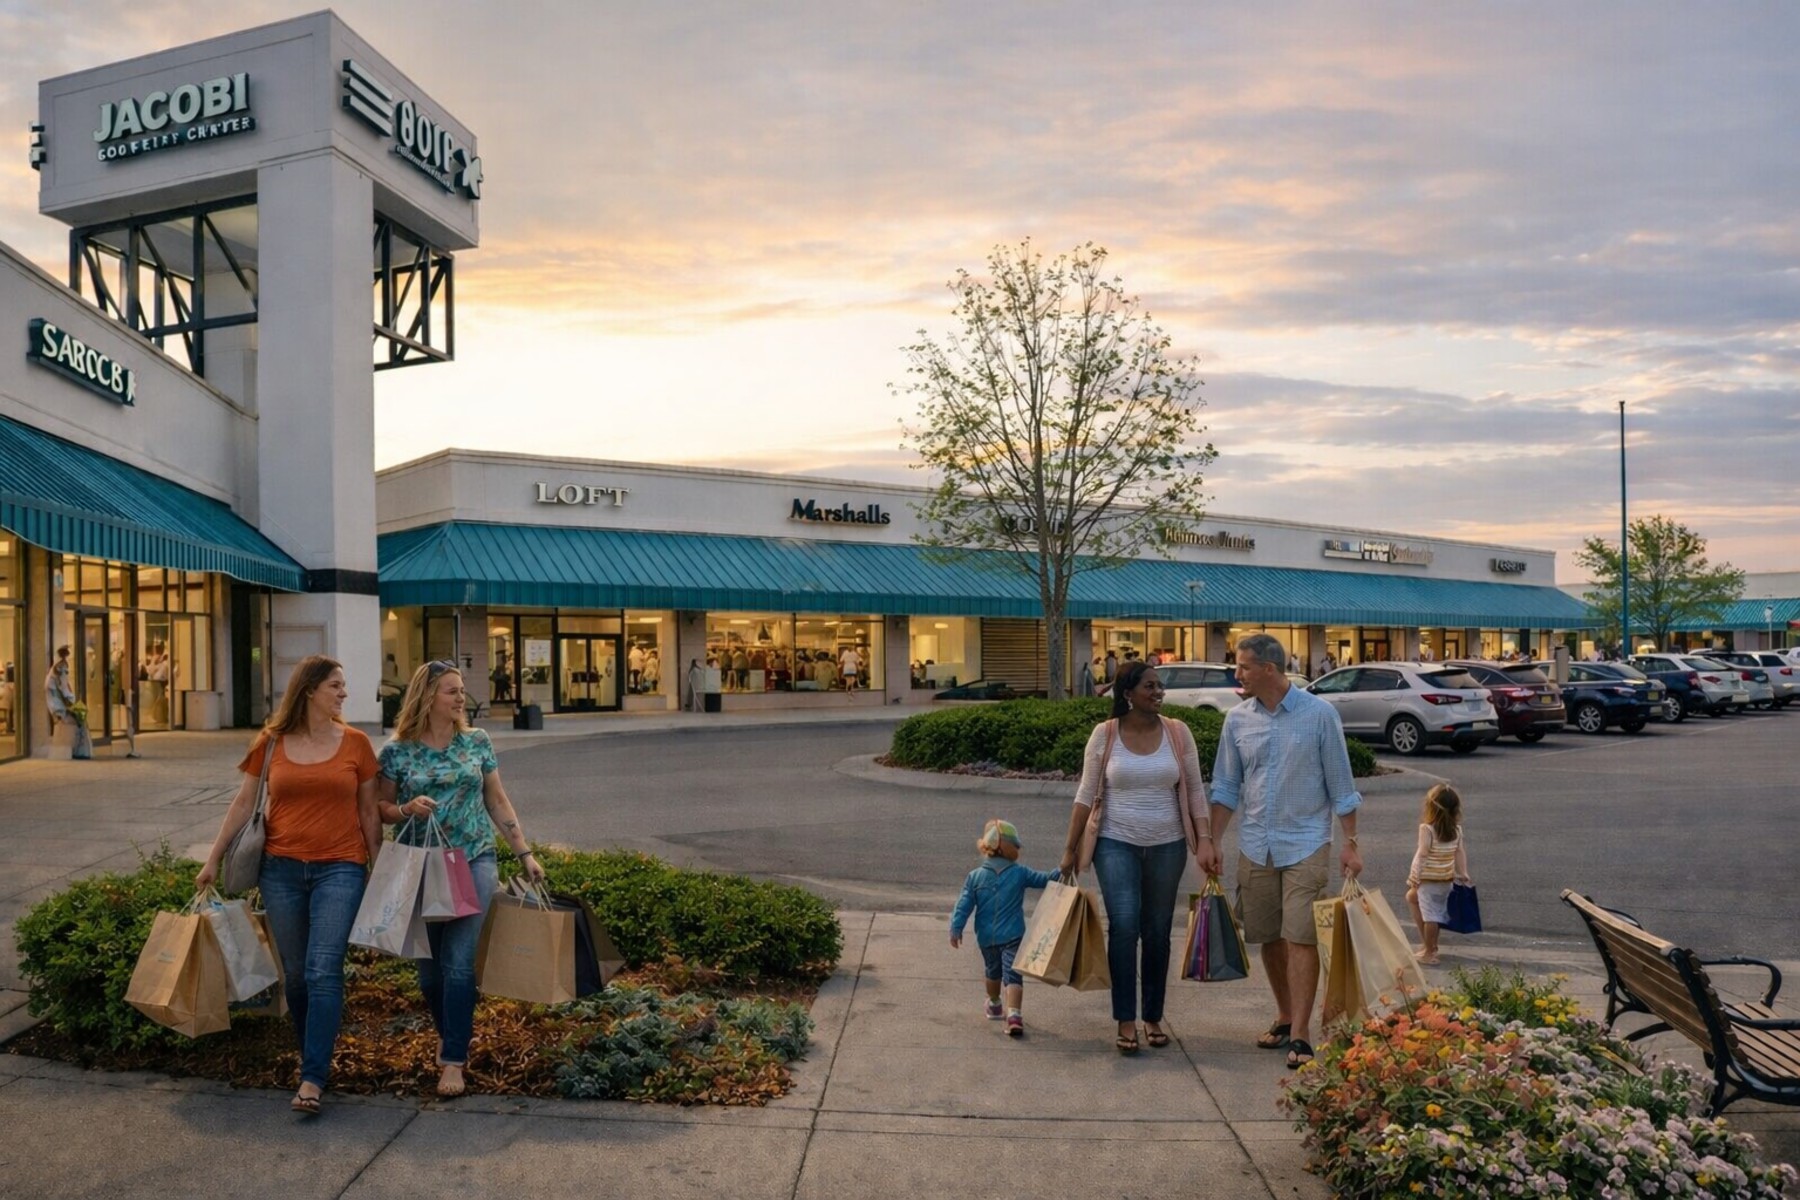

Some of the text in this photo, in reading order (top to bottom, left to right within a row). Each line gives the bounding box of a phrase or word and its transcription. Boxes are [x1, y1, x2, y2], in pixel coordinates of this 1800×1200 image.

[93, 72, 250, 143] JACOBI
[535, 481, 631, 507] LOFT
[790, 498, 891, 525] Marshalls
